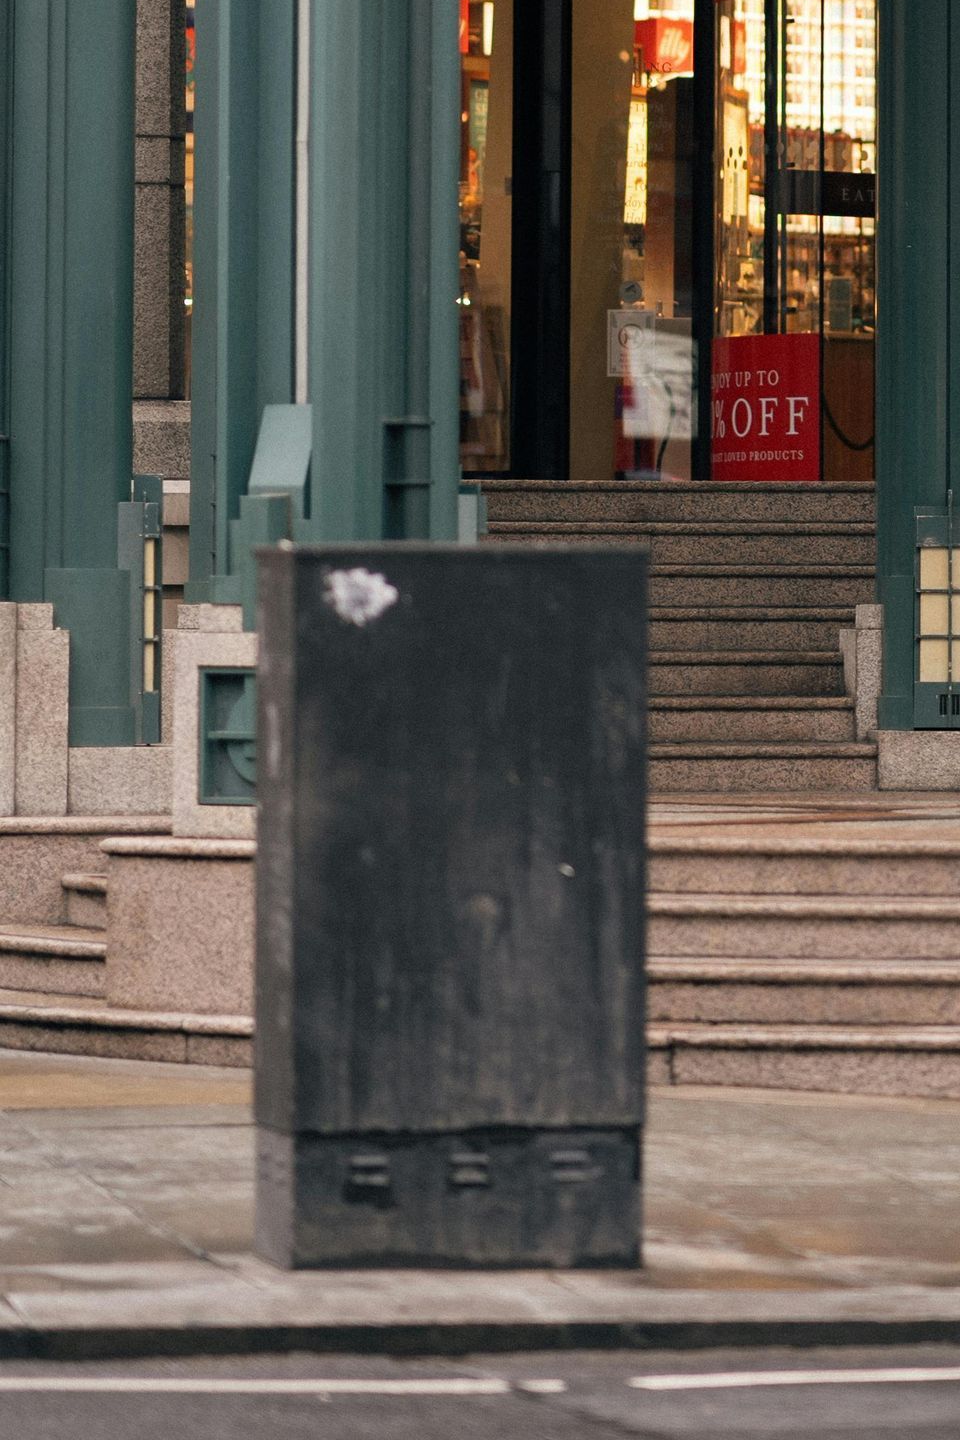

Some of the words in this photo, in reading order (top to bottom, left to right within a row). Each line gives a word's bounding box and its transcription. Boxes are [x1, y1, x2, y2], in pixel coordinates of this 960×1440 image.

[842, 187, 875, 203] EAT
[735, 371, 751, 388] UP
[756, 369, 779, 387] TO
[731, 396, 809, 438] OFF
[724, 451, 746, 463] LOVED
[749, 450, 804, 462] PRODUCTS
